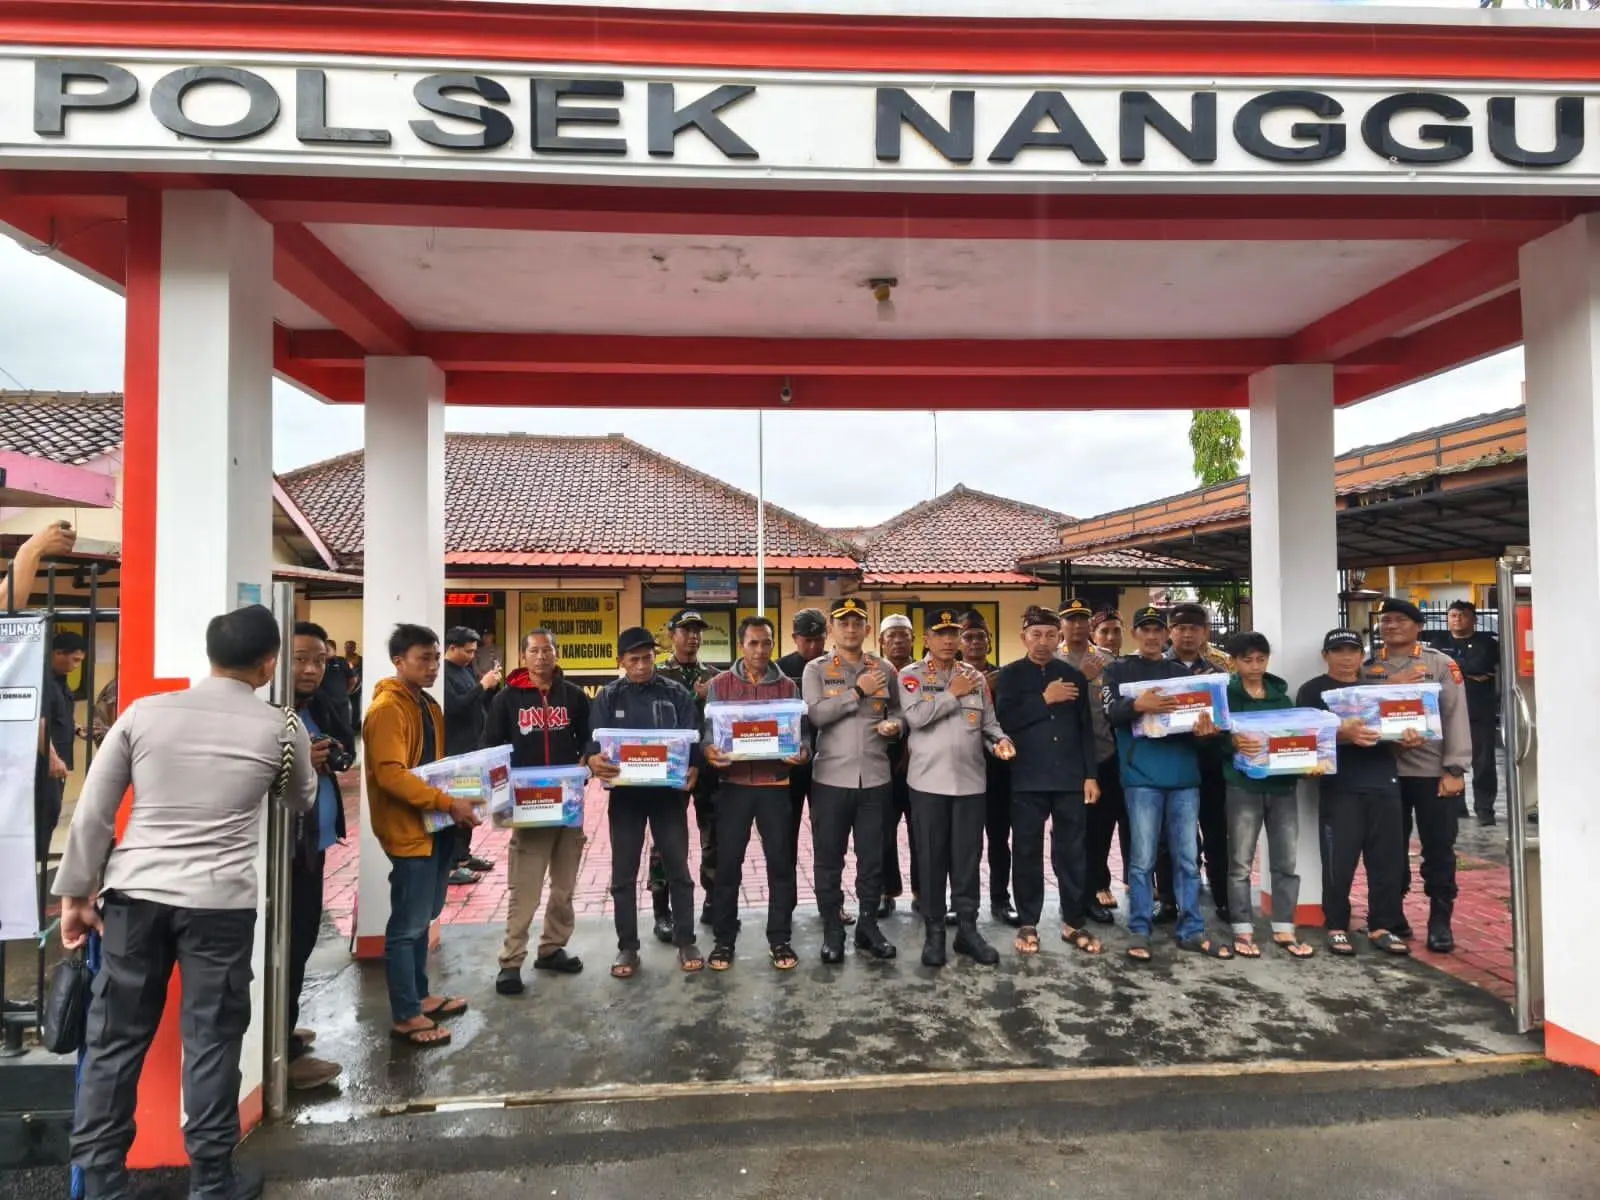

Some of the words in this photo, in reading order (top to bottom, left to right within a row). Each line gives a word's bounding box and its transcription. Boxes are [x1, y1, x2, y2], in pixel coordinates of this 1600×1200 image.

[33, 59, 759, 159] POLSEK
[876, 88, 1585, 167] NANGGU
[0, 623, 41, 636] HUMAS
[562, 643, 613, 658] NANGGUNG
